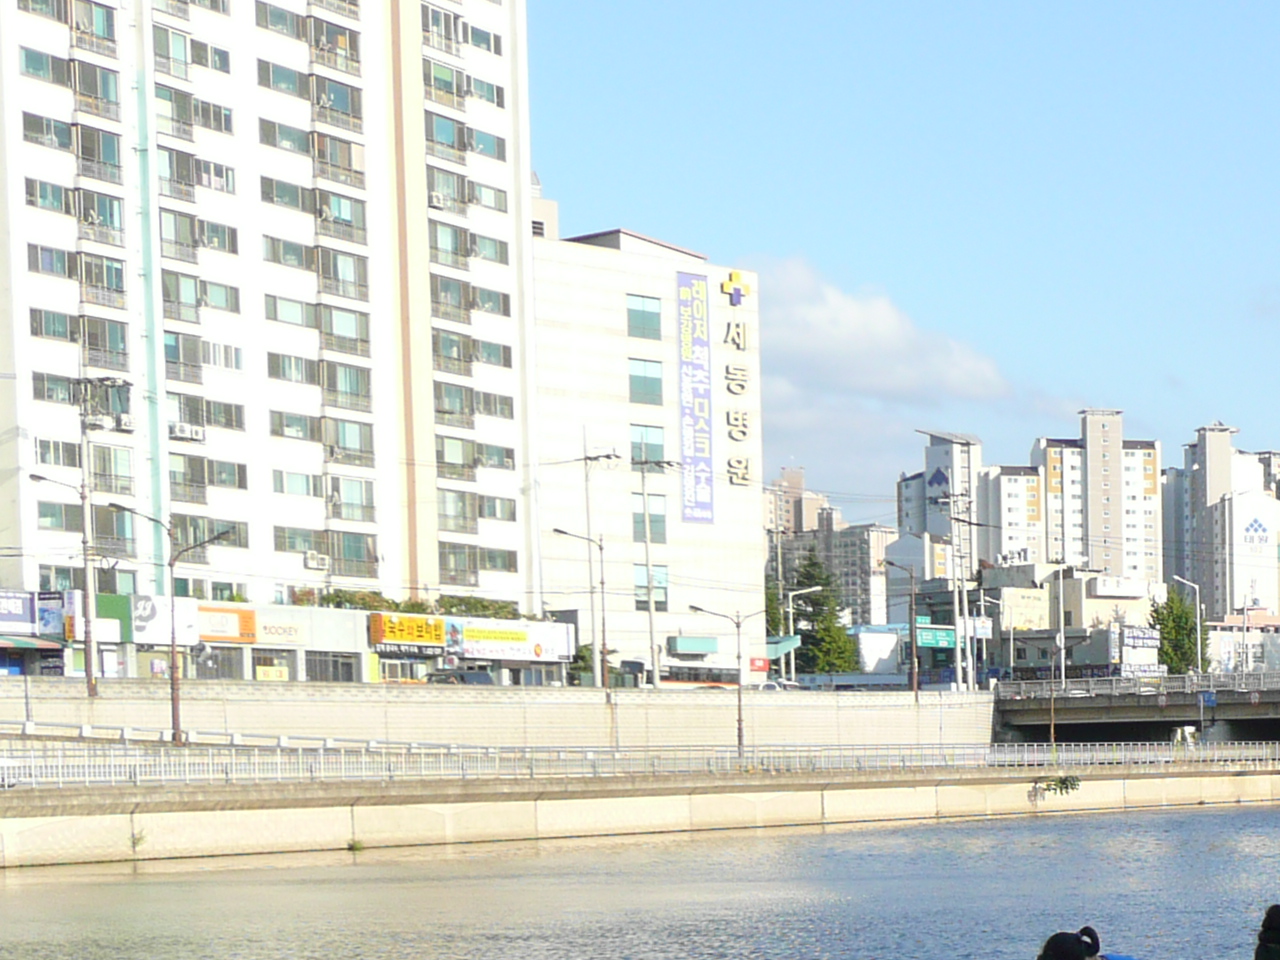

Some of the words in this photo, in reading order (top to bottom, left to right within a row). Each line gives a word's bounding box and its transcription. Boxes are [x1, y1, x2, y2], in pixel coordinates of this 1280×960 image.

[690, 279, 708, 342] 레이저
[692, 345, 710, 394] 척추
[694, 397, 711, 458] 디스크
